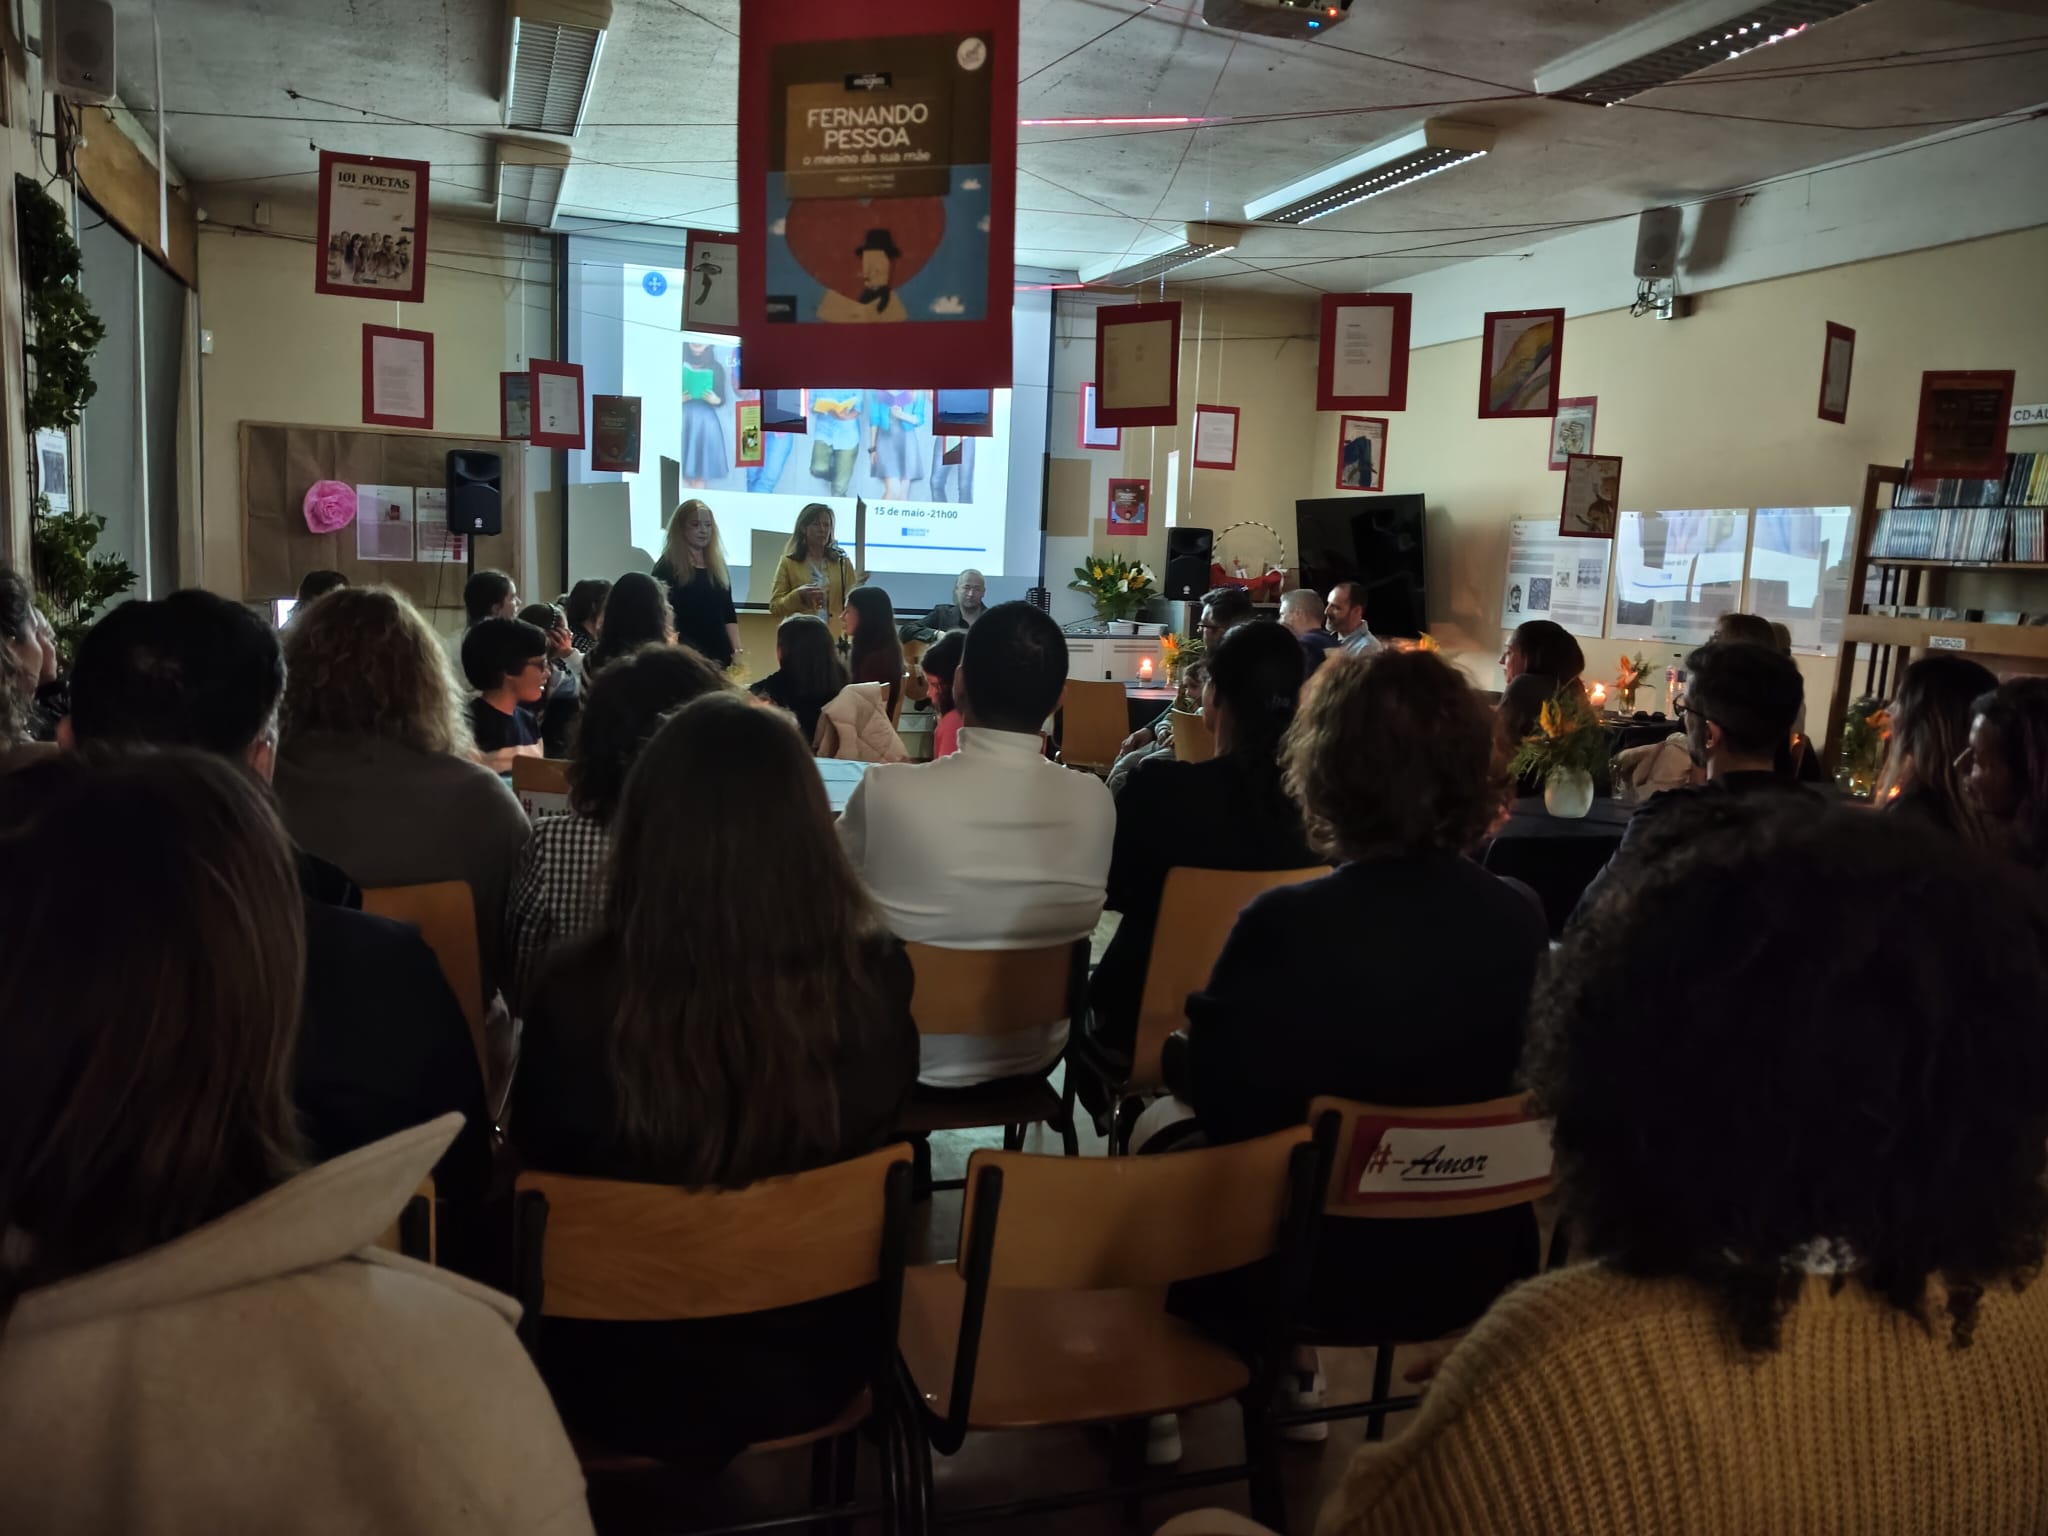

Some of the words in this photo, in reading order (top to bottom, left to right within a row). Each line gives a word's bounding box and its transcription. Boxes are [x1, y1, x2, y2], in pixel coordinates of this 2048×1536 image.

[807, 102, 929, 129] FERNANDO
[823, 126, 911, 150] PESSOA
[802, 156, 811, 166] o
[813, 152, 859, 166] menino
[860, 150, 877, 164] da
[879, 151, 901, 163] sua
[338, 171, 356, 183] 101
[362, 174, 410, 189] POETAS
[874, 506, 885, 515] 15
[887, 507, 899, 516] de
[901, 508, 925, 517] maio
